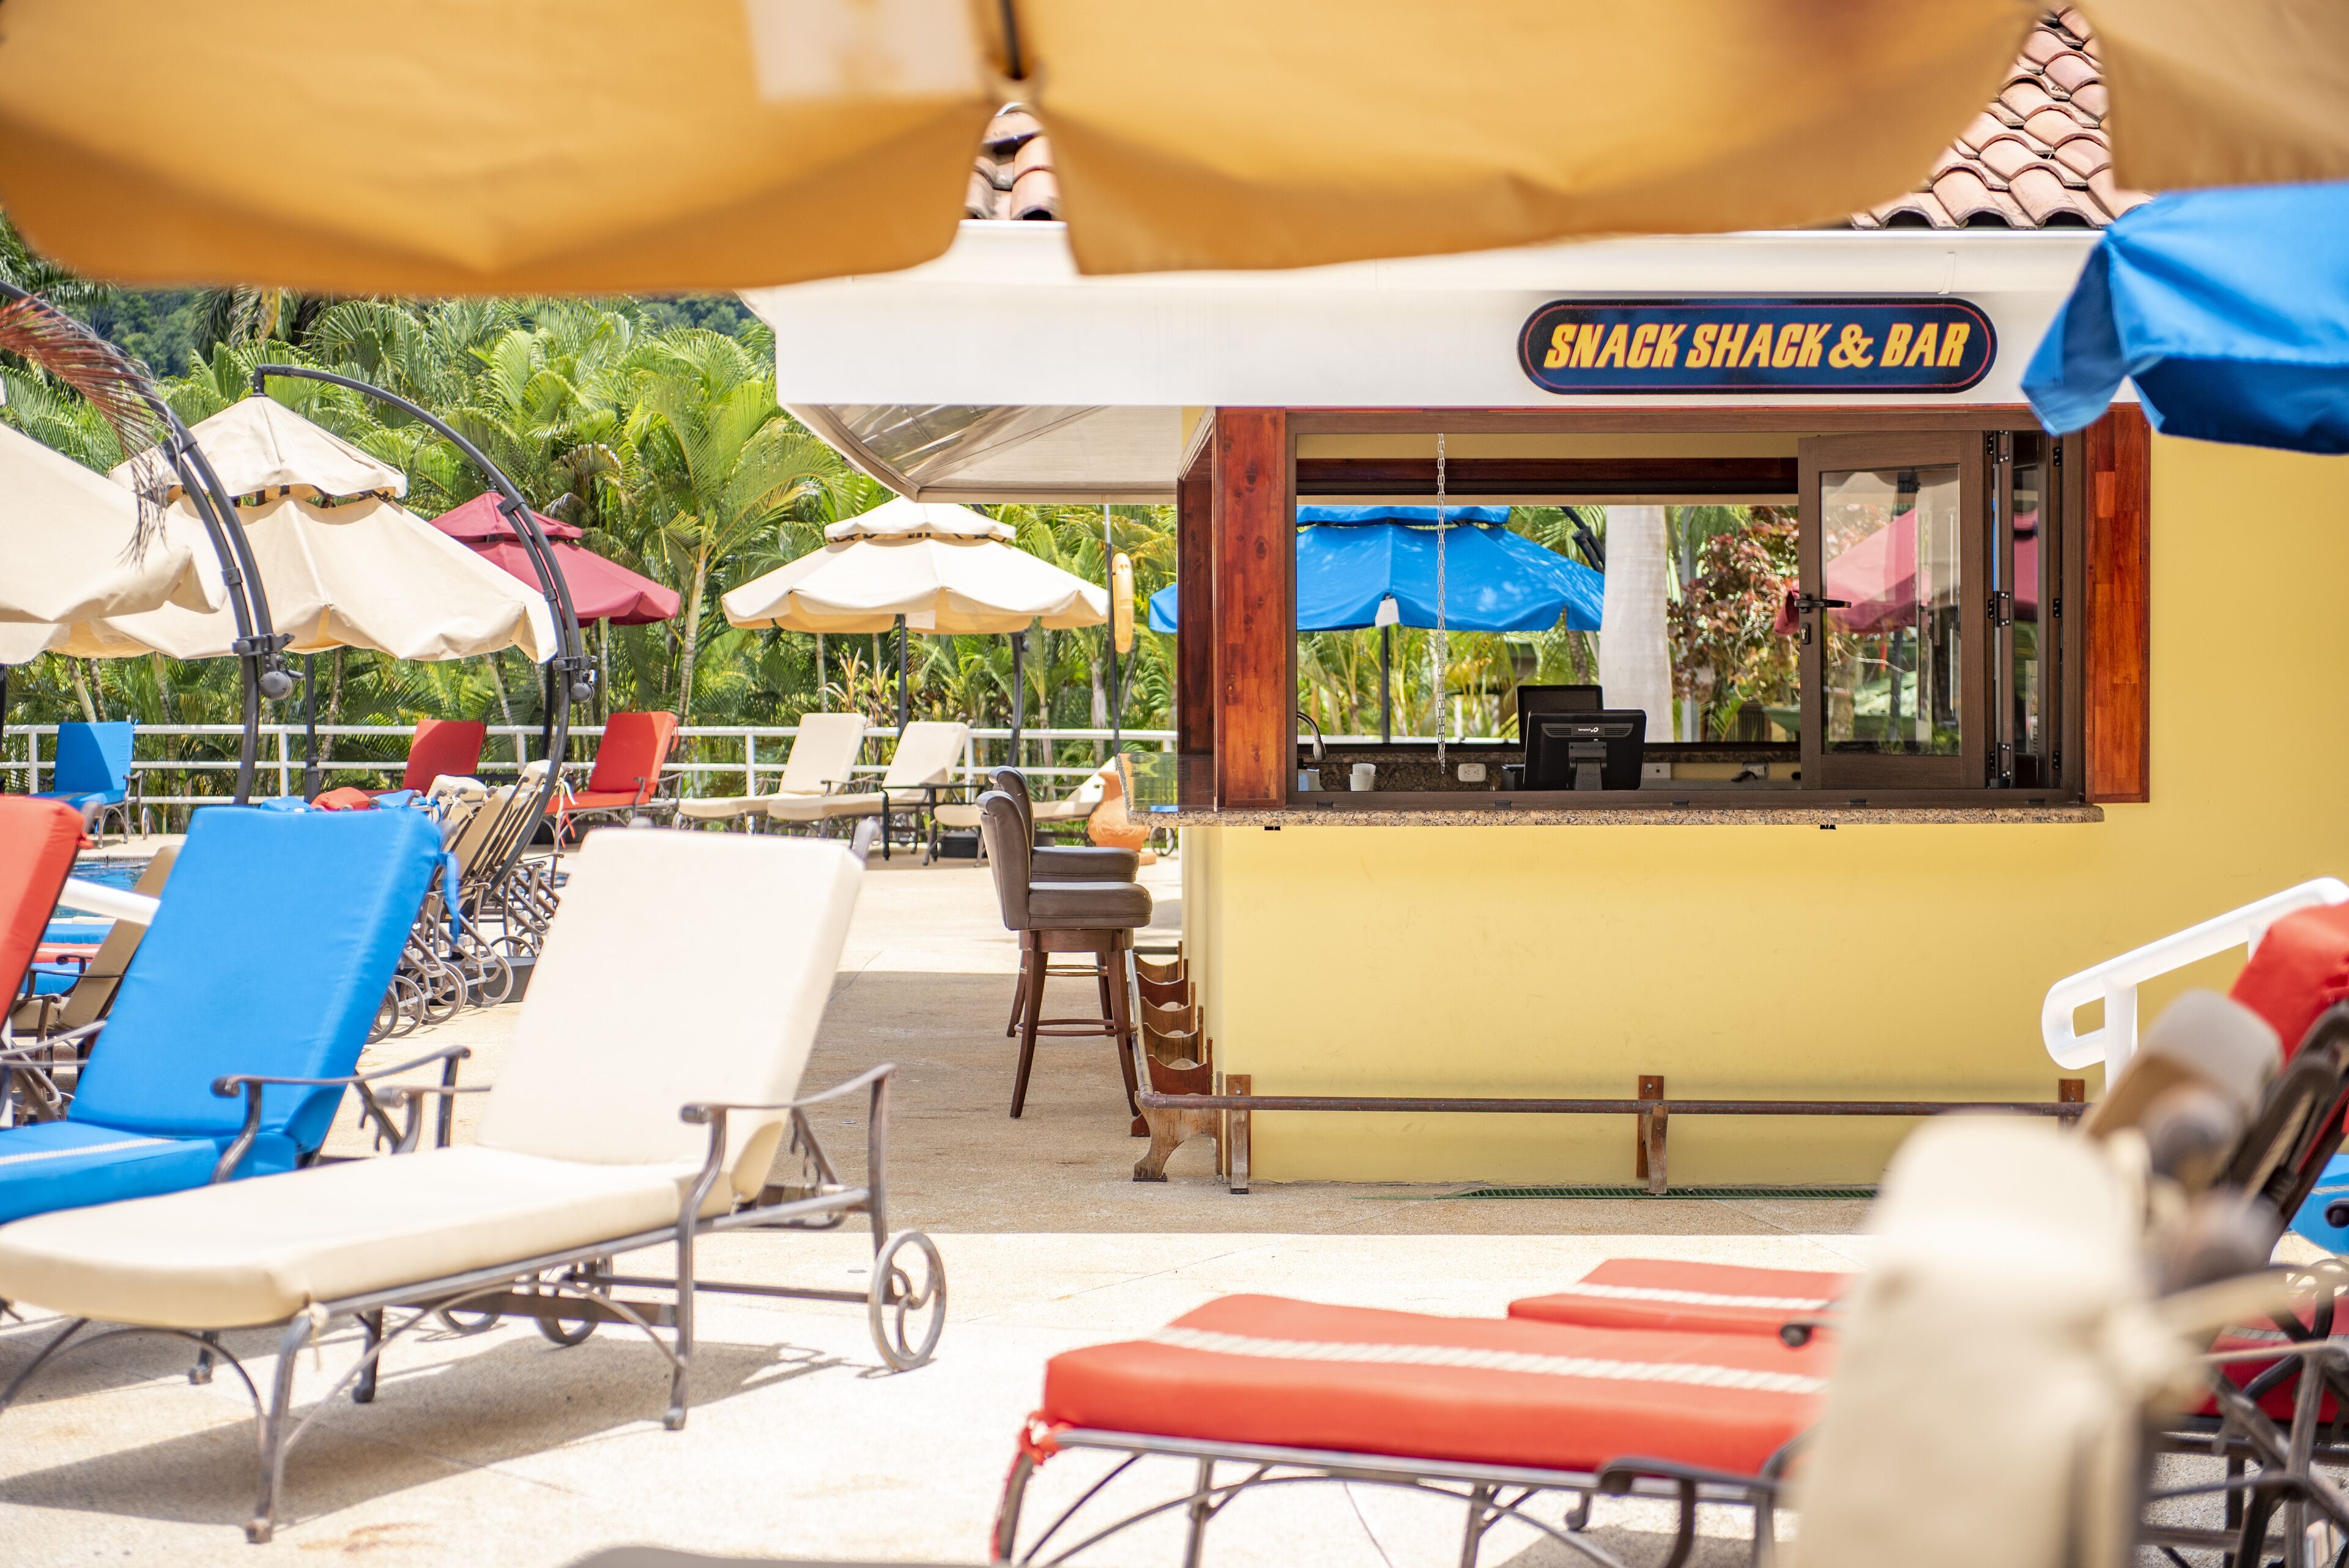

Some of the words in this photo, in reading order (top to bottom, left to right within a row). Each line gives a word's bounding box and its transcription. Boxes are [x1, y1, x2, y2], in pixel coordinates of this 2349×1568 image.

[1543, 323, 1688, 369] SNACK
[1684, 323, 1833, 369] SHACK
[1828, 322, 1874, 369] &
[1879, 322, 1971, 368] BAR
